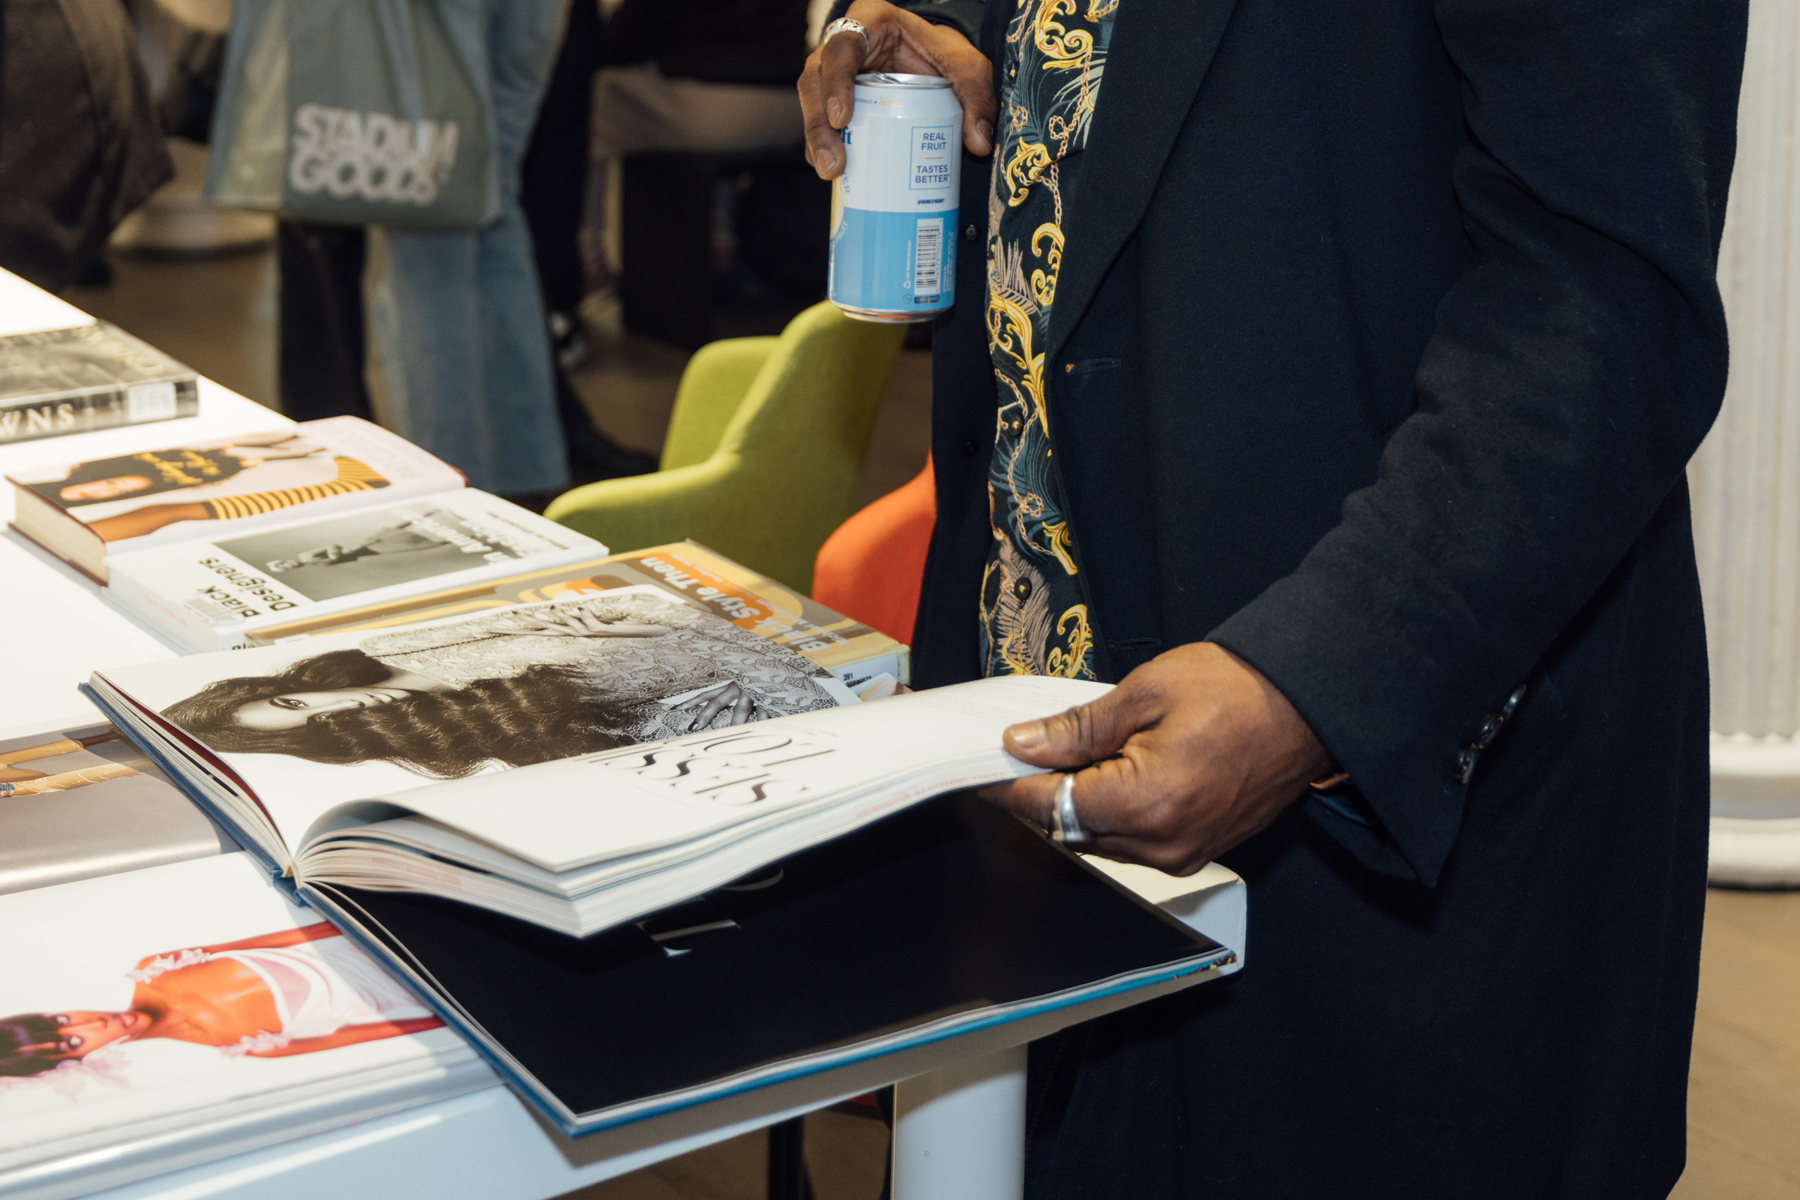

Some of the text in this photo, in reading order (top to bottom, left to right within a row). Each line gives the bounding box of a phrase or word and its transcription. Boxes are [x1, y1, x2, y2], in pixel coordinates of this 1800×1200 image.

[878, 97, 906, 107] lemon
[921, 141, 947, 151] FRUIT
[922, 132, 947, 141] REAL
[916, 164, 949, 174] TASTES
[198, 557, 299, 611] Designers
[640, 557, 699, 590] Then
[196, 585, 262, 618] Black
[696, 586, 761, 619] Style
[753, 616, 832, 653] Black
[843, 672, 853, 681] 391
